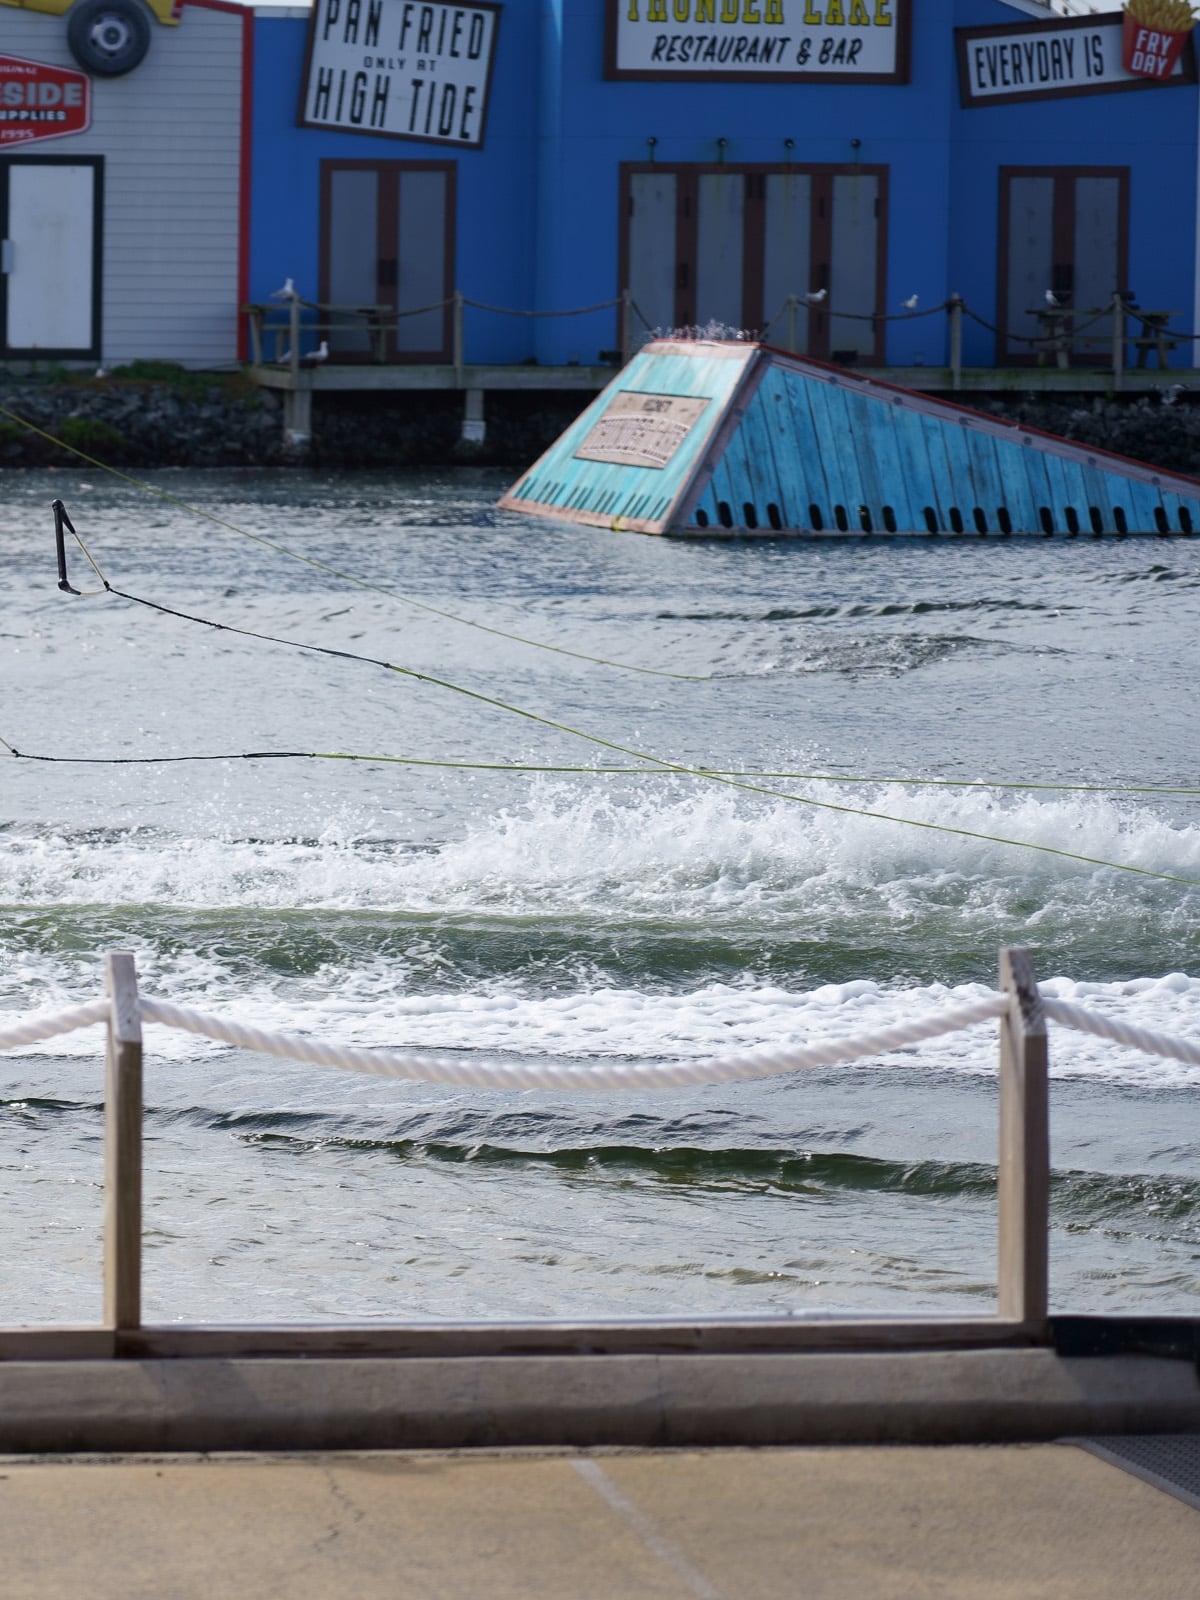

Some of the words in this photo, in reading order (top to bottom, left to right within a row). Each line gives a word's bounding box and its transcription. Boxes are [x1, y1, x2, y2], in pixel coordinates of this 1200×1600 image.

[323, 0, 383, 47] PAN
[398, 4, 485, 60] FRIED
[1135, 29, 1173, 56] FRY
[363, 56, 406, 70] ONLY
[417, 59, 437, 72] AT
[651, 34, 791, 63] RESTAURANT
[796, 38, 812, 65] &
[818, 38, 863, 65] BAR
[975, 37, 1075, 89] EVERYDAY
[1084, 34, 1104, 77] IS
[1131, 53, 1168, 76] DAY
[313, 66, 390, 128] HIGH
[409, 78, 477, 139] TIDE
